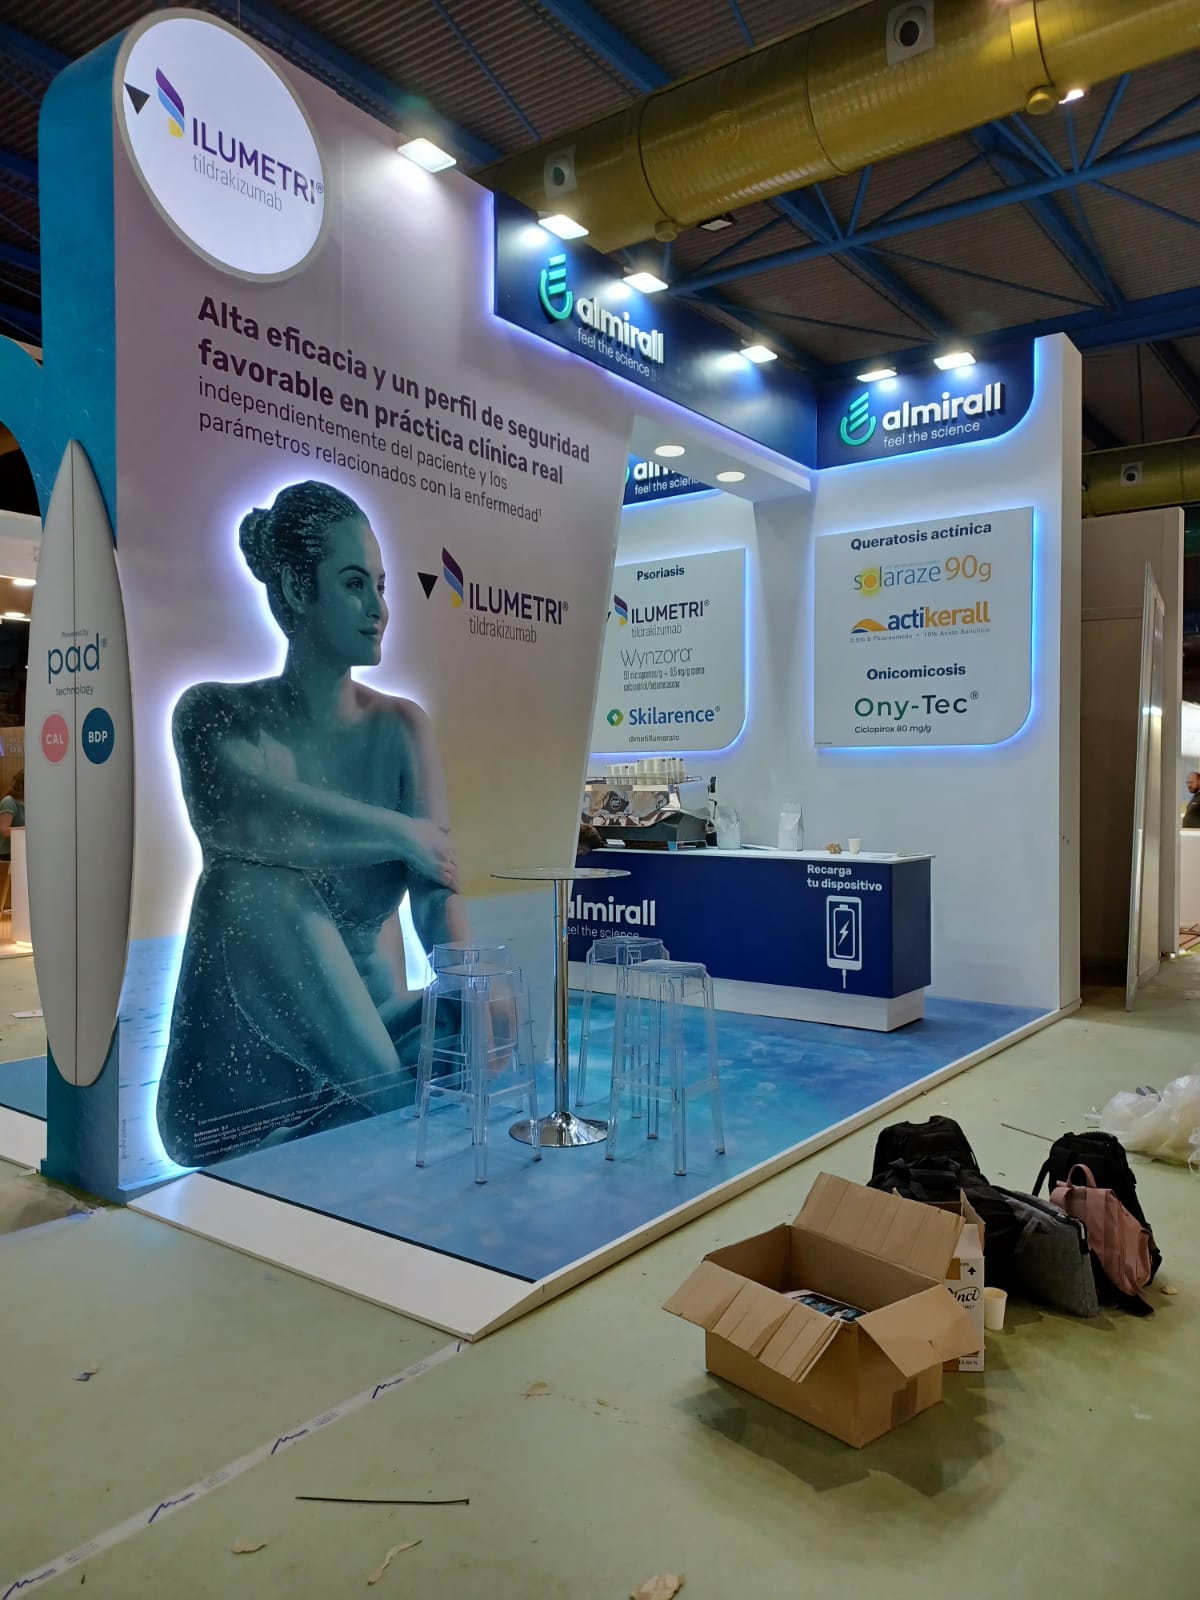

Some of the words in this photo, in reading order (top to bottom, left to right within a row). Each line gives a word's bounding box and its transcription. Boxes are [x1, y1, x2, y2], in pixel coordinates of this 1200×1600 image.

[193, 153, 283, 212] tildrakizumab
[576, 297, 664, 364] almirall
[577, 328, 596, 350] feel
[598, 339, 614, 358] the
[615, 350, 650, 377] science
[198, 296, 259, 340] Alta
[266, 326, 367, 380] eficacia
[373, 366, 386, 391] y
[392, 373, 419, 399] un
[425, 386, 477, 421] perfil
[481, 405, 504, 430] de
[508, 418, 590, 463] seguridad
[198, 338, 334, 406] favorable
[340, 392, 369, 419] en
[375, 405, 464, 451] práctica
[468, 437, 528, 473] clínica
[532, 460, 563, 485] real
[882, 382, 1002, 431] almirall
[199, 375, 387, 452] independientemente
[390, 439, 413, 461] del
[417, 449, 476, 480] paciente
[479, 469, 487, 487] y
[490, 469, 508, 490] los
[883, 432, 905, 449] feel
[908, 430, 928, 443] the
[931, 421, 980, 439] science
[199, 412, 311, 457] parámetros
[315, 446, 417, 488] relacionados
[420, 477, 446, 497] con
[450, 482, 461, 500] la
[634, 484, 651, 496] feel
[653, 481, 668, 492] the
[850, 529, 928, 551] Queratosis
[930, 522, 992, 540] actínica
[636, 565, 685, 581] Psoriasis
[853, 565, 941, 591] solaraze
[945, 554, 992, 582] 90g
[468, 615, 537, 644] tildrakizumab
[887, 600, 991, 631] actikerall
[631, 624, 682, 638] tildrakizumab
[866, 662, 966, 681] Onicomicosis
[55, 684, 95, 697] technology
[45, 733, 65, 745] CAL
[88, 730, 108, 743] BDP
[854, 725, 895, 735] Ciclopirox
[896, 724, 908, 733] 80
[909, 723, 932, 734] mg/g
[806, 877, 819, 888] tu
[821, 878, 883, 892] dispositivo
[807, 864, 852, 878] Recarga
[581, 925, 598, 937] the
